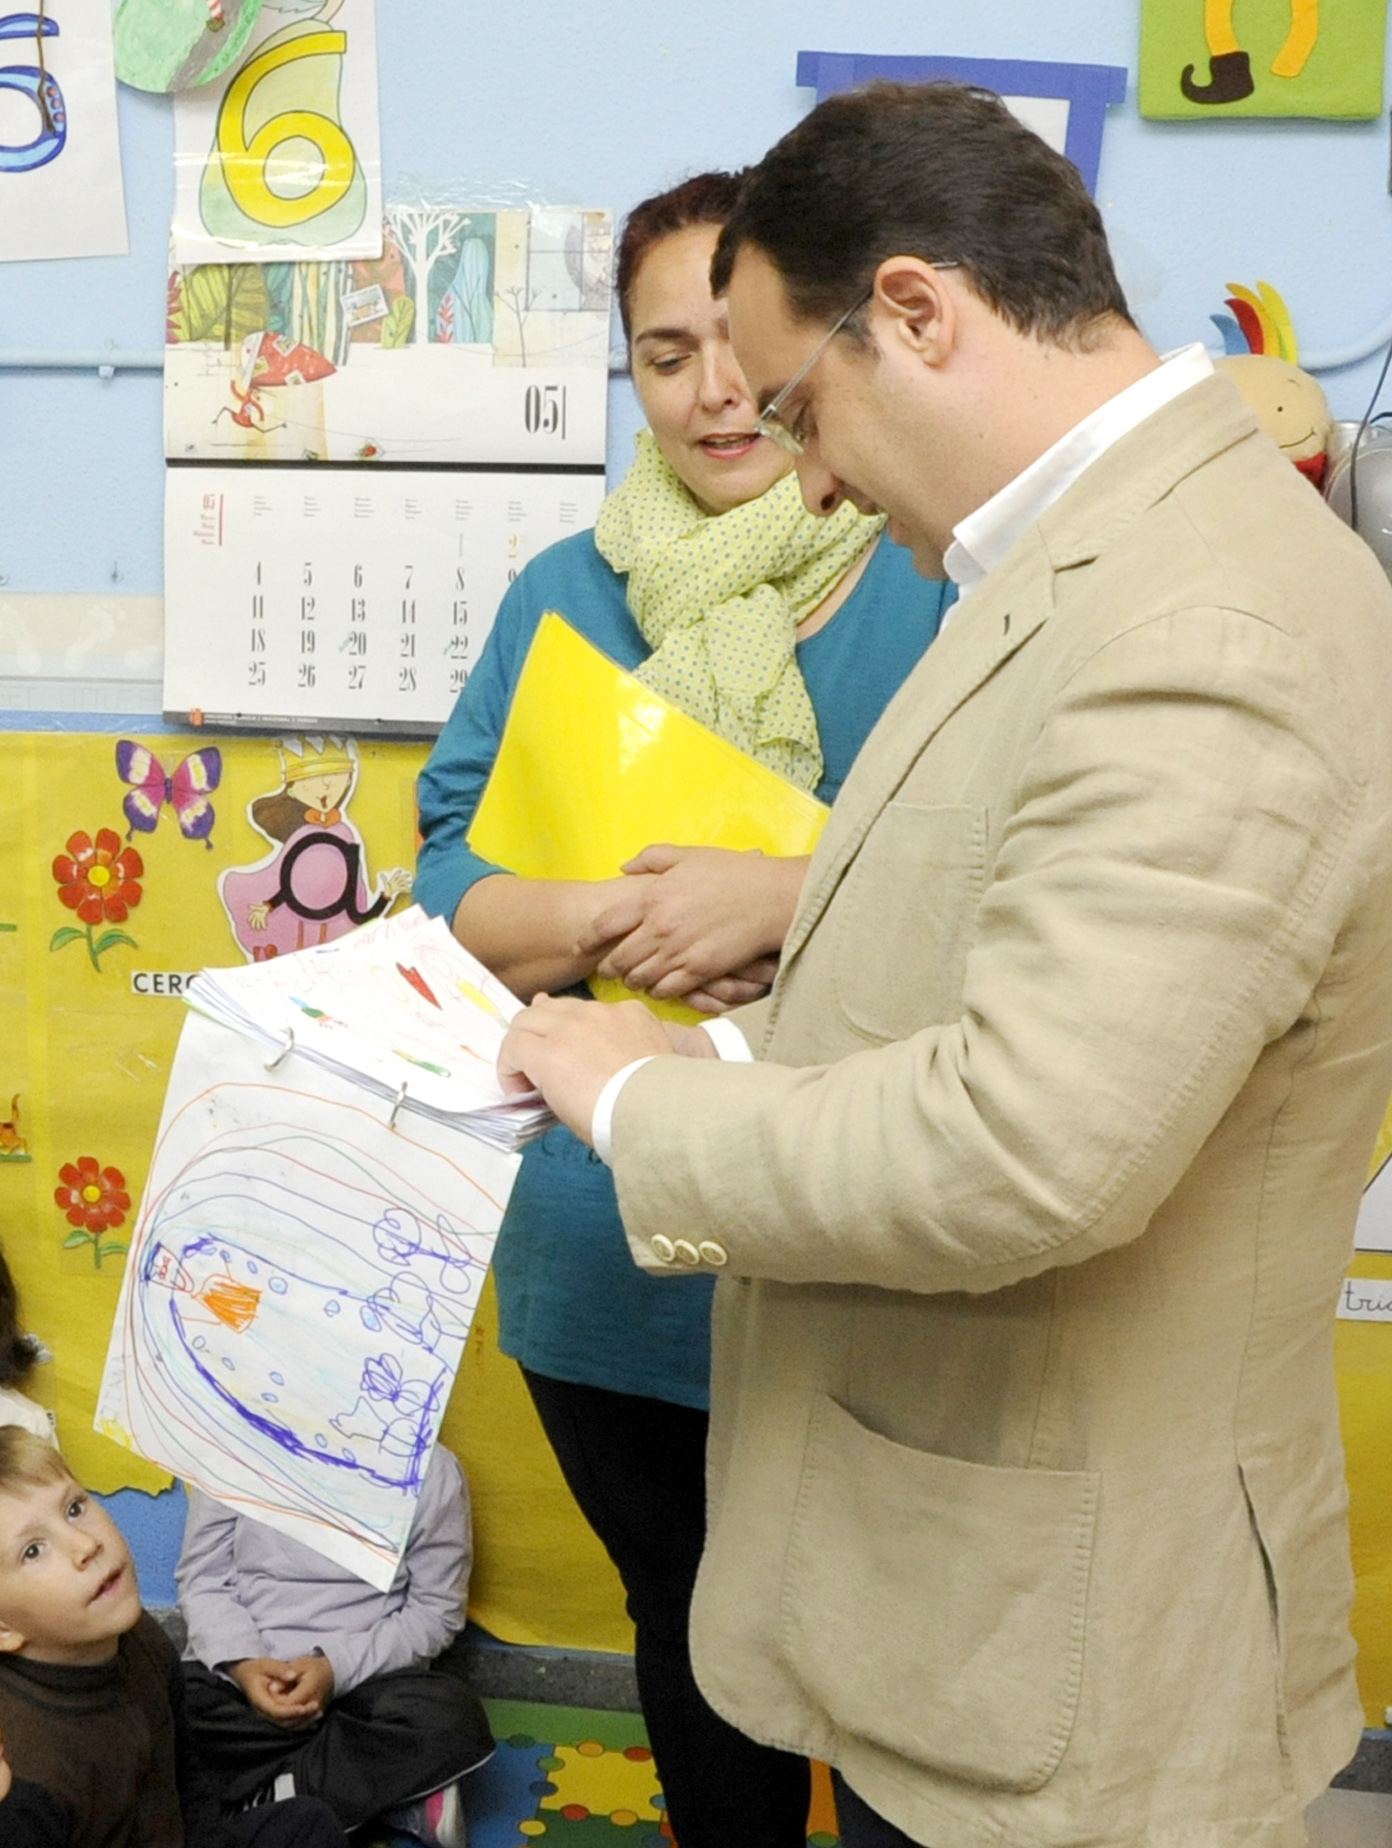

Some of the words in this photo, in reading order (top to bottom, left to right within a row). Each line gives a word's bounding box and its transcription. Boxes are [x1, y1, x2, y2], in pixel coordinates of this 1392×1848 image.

[217, 30, 356, 228] 6
[304, 562, 312, 586] 5
[354, 564, 363, 588] 6
[405, 565, 413, 590] 7
[456, 567, 465, 591] 8
[253, 595, 263, 619] 11
[301, 596, 315, 621] 12
[351, 598, 366, 622] 13
[402, 599, 415, 624] 14
[453, 601, 468, 625] 15
[251, 628, 265, 652] 18
[301, 630, 315, 654] 19
[348, 631, 367, 656] 20
[400, 633, 415, 658] 21
[450, 634, 469, 660] 22
[248, 661, 266, 686] 25
[298, 663, 316, 688] 26
[348, 665, 366, 690] 27
[399, 667, 416, 691] 28
